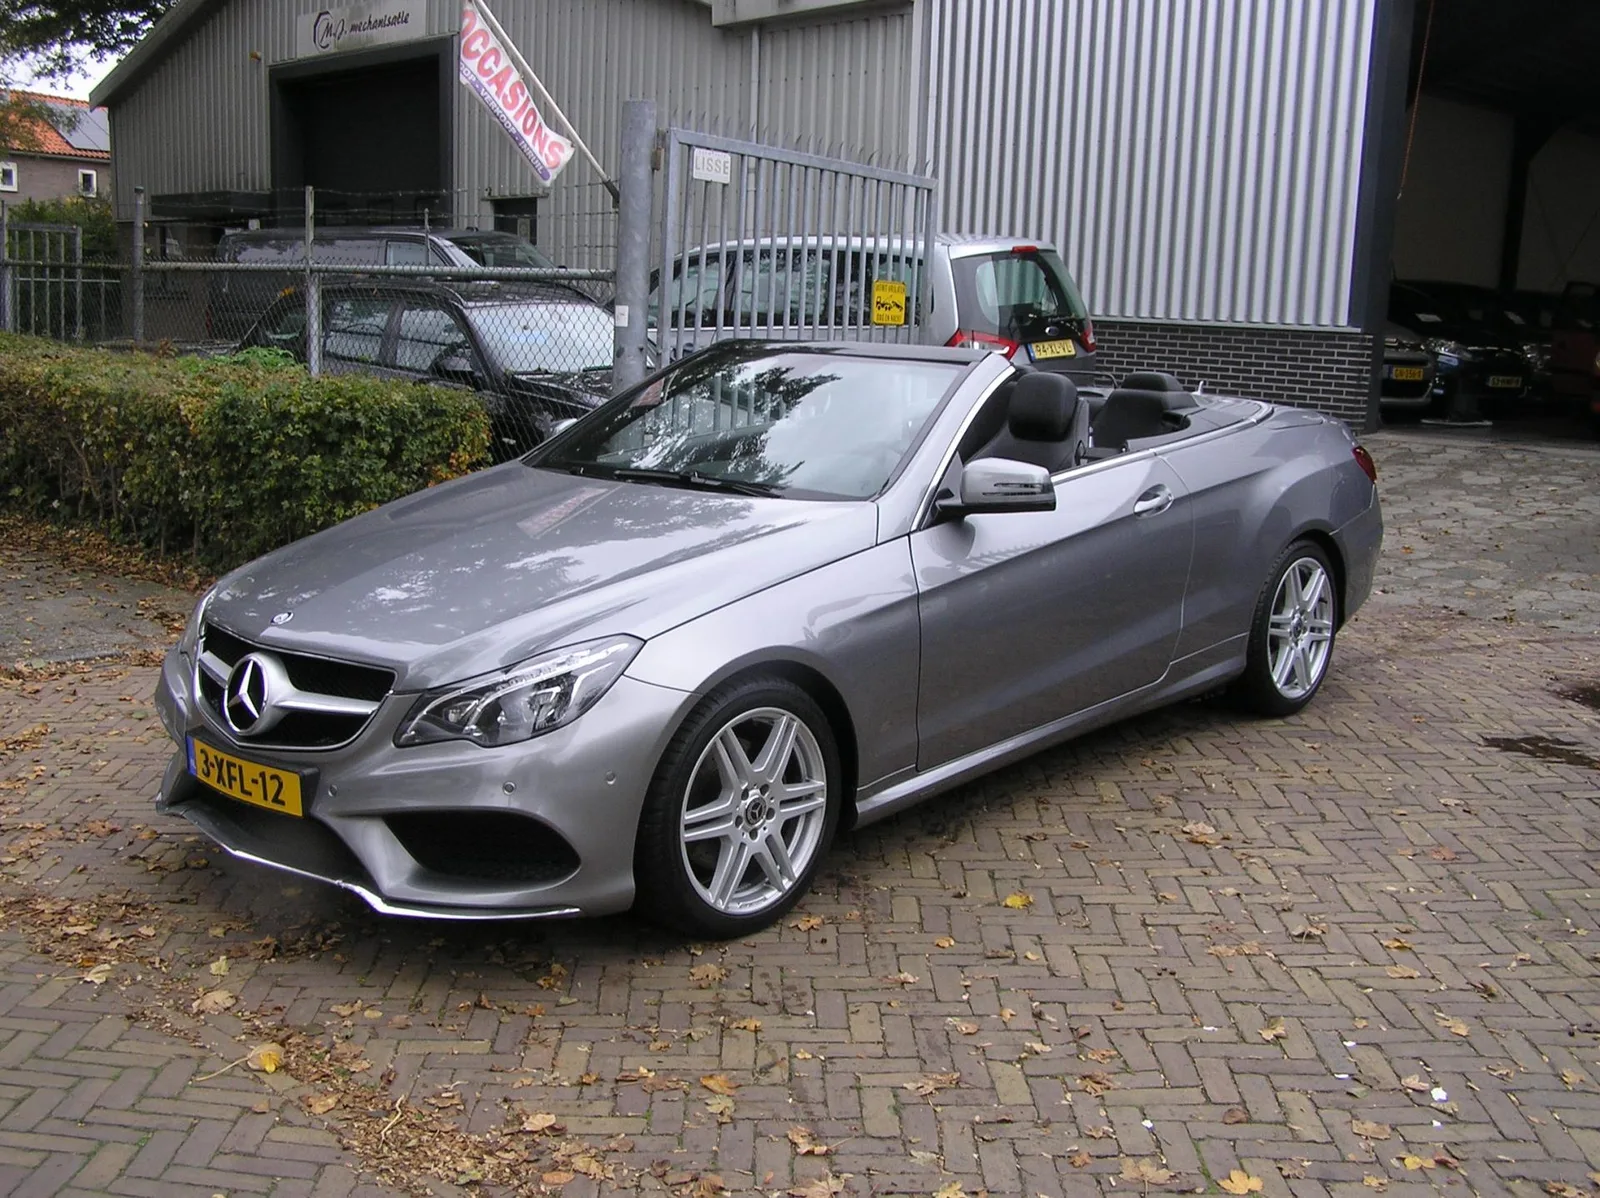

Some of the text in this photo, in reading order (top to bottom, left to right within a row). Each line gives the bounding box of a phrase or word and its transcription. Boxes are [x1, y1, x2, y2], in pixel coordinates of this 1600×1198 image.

[350, 11, 410, 33] mechanisatie
[480, 88, 517, 135] VERKOOP
[519, 140, 544, 175] INRUIL
[695, 157, 730, 175] LISSE
[200, 748, 285, 806] 3-XFL-12
